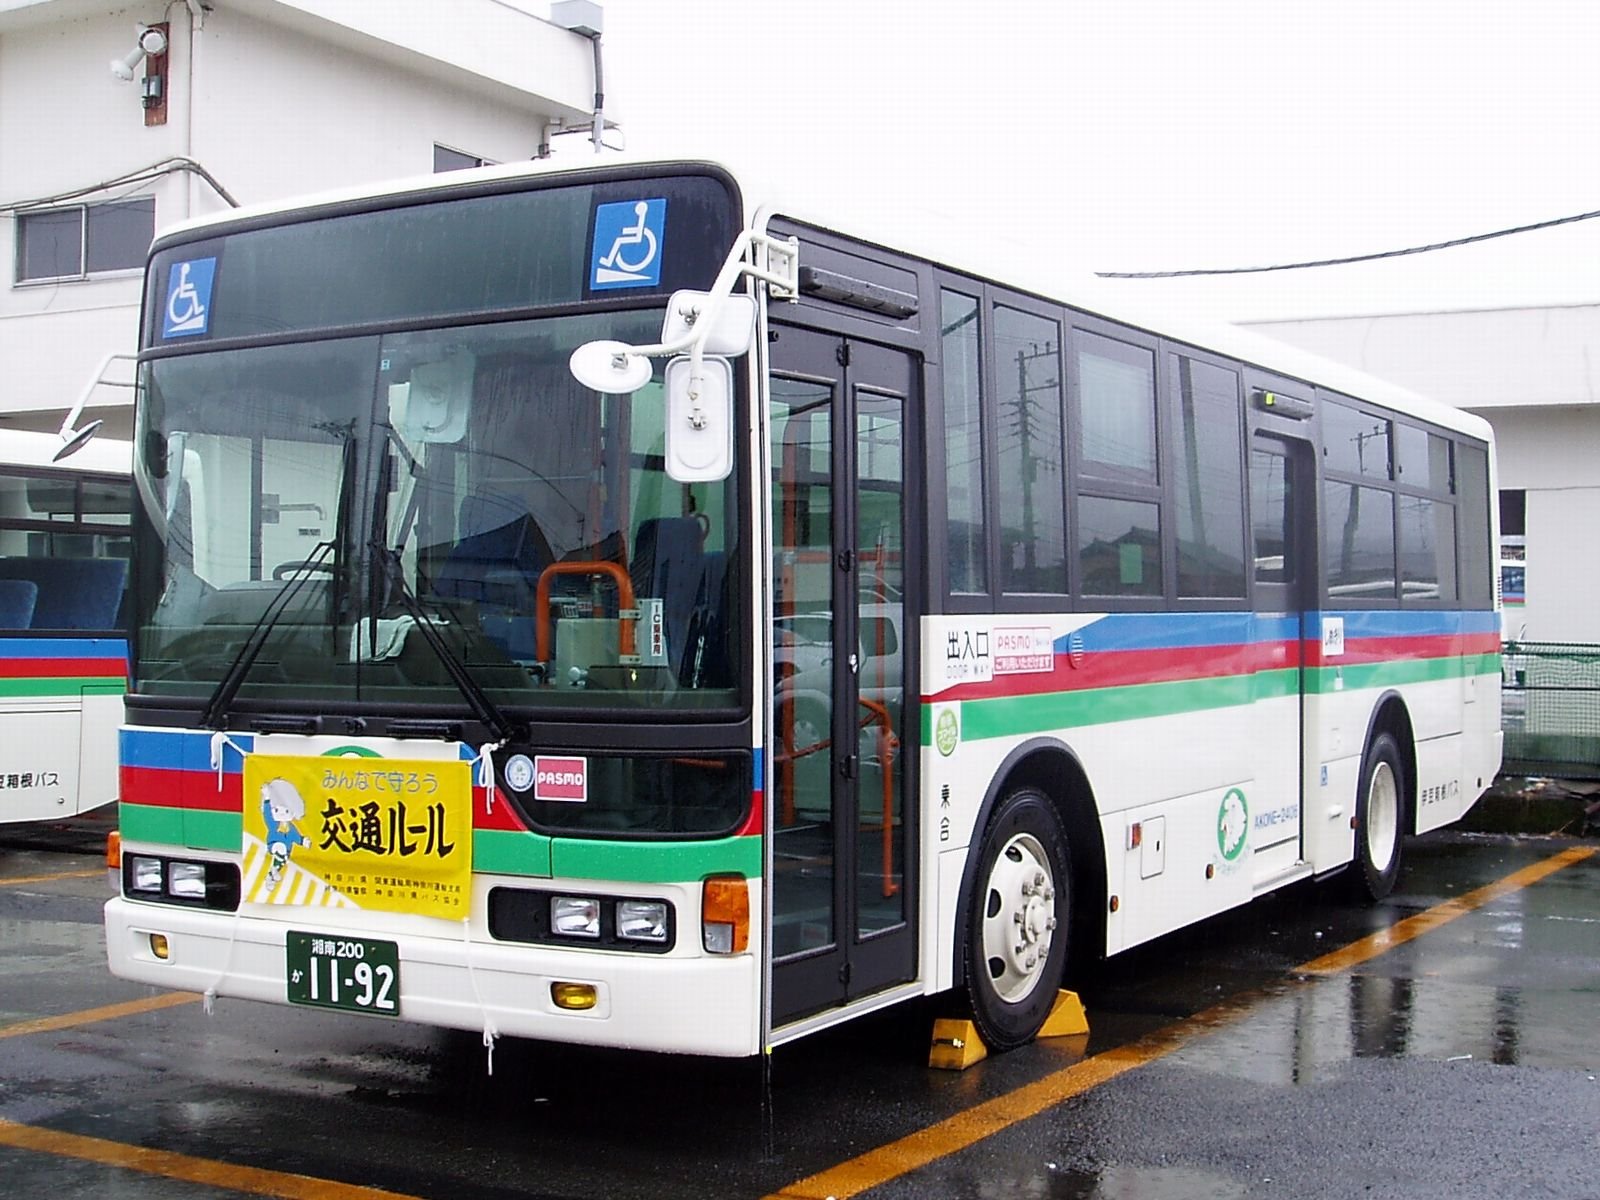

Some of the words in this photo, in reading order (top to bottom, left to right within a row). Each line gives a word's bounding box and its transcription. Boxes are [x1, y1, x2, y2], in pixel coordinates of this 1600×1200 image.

[947, 631, 989, 659] 出入口
[997, 635, 1030, 650] PASMO
[321, 768, 438, 794] みんなで守ろう
[537, 771, 584, 786] PASMO
[318, 798, 456, 858] 交通ルール
[311, 938, 364, 959] 湘南200
[291, 968, 303, 983] か
[310, 956, 395, 1009] 11-92
